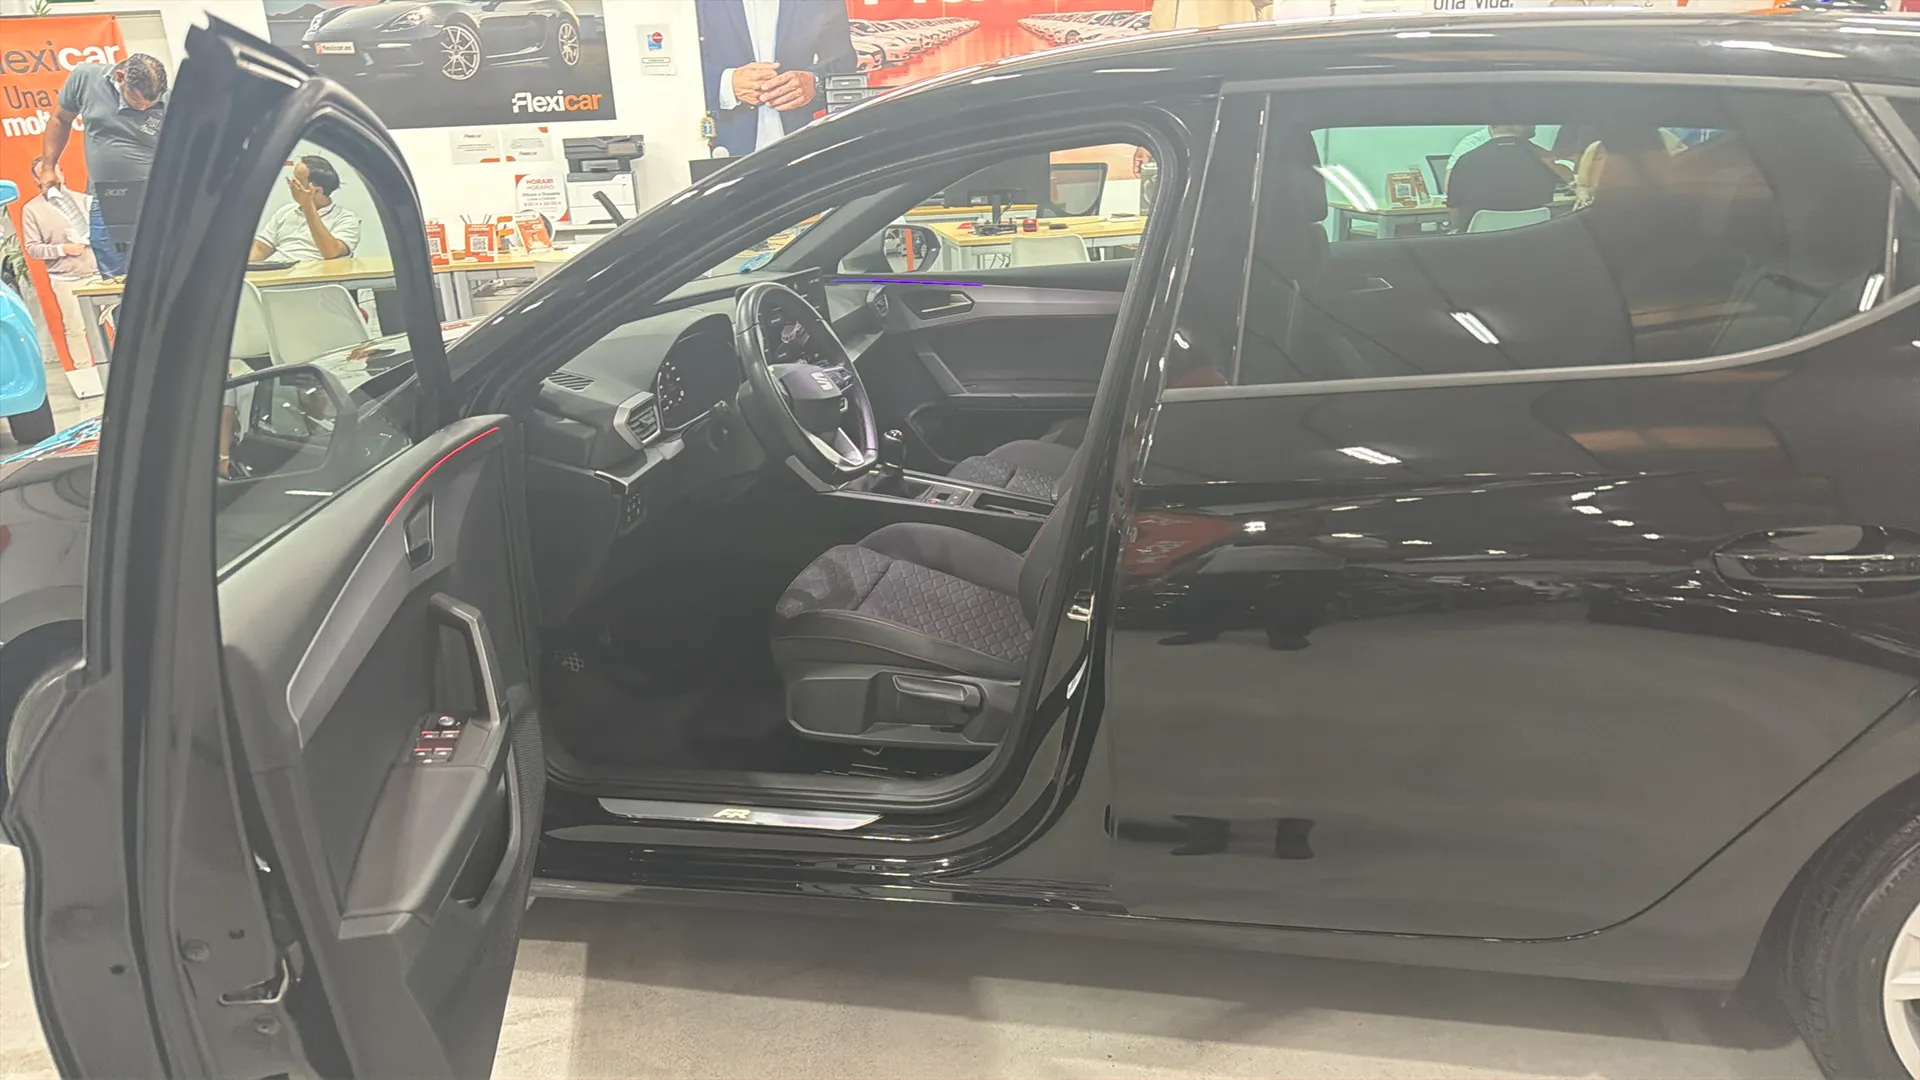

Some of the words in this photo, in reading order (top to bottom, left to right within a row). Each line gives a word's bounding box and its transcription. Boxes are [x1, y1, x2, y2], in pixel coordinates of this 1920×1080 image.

[4, 85, 51, 110] Una
[511, 89, 603, 113] Flexicar
[104, 188, 128, 197] acer
